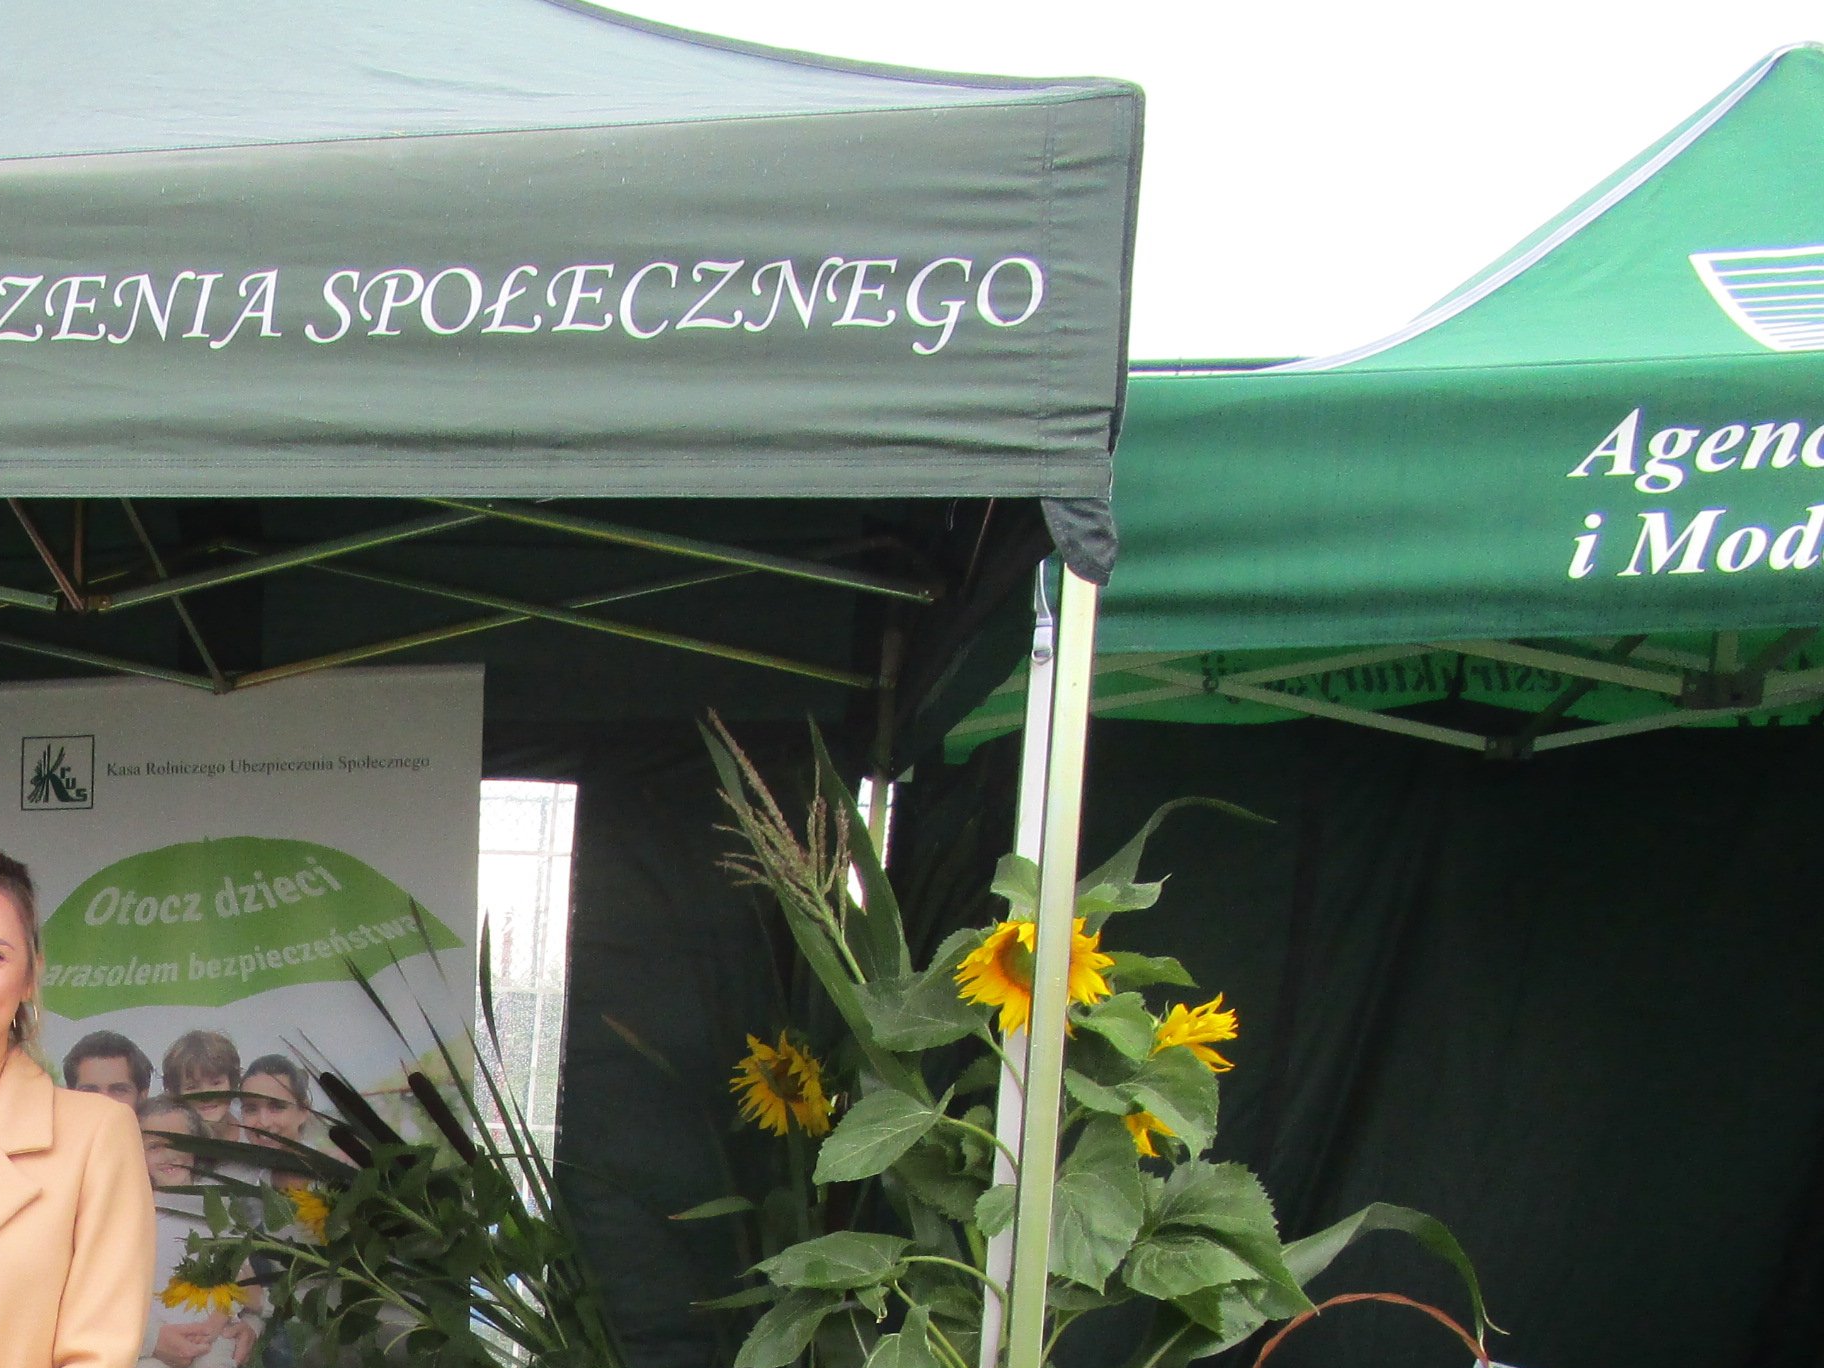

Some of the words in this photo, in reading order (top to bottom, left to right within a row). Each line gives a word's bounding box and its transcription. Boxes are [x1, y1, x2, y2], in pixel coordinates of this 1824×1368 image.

[305, 255, 1045, 354] SPOŁECZNEGO
[1567, 512, 1603, 579] i
[1616, 502, 1824, 576] Mod
[106, 761, 141, 777] Kasa
[146, 760, 226, 778] Rolniczego
[230, 756, 333, 777] Ubezpieczenia
[337, 753, 430, 774] Społecznego
[84, 886, 203, 926] Otocz
[215, 856, 344, 919] dzieci
[41, 957, 178, 988] arasolem
[188, 913, 424, 983] bezpieczeństwa
